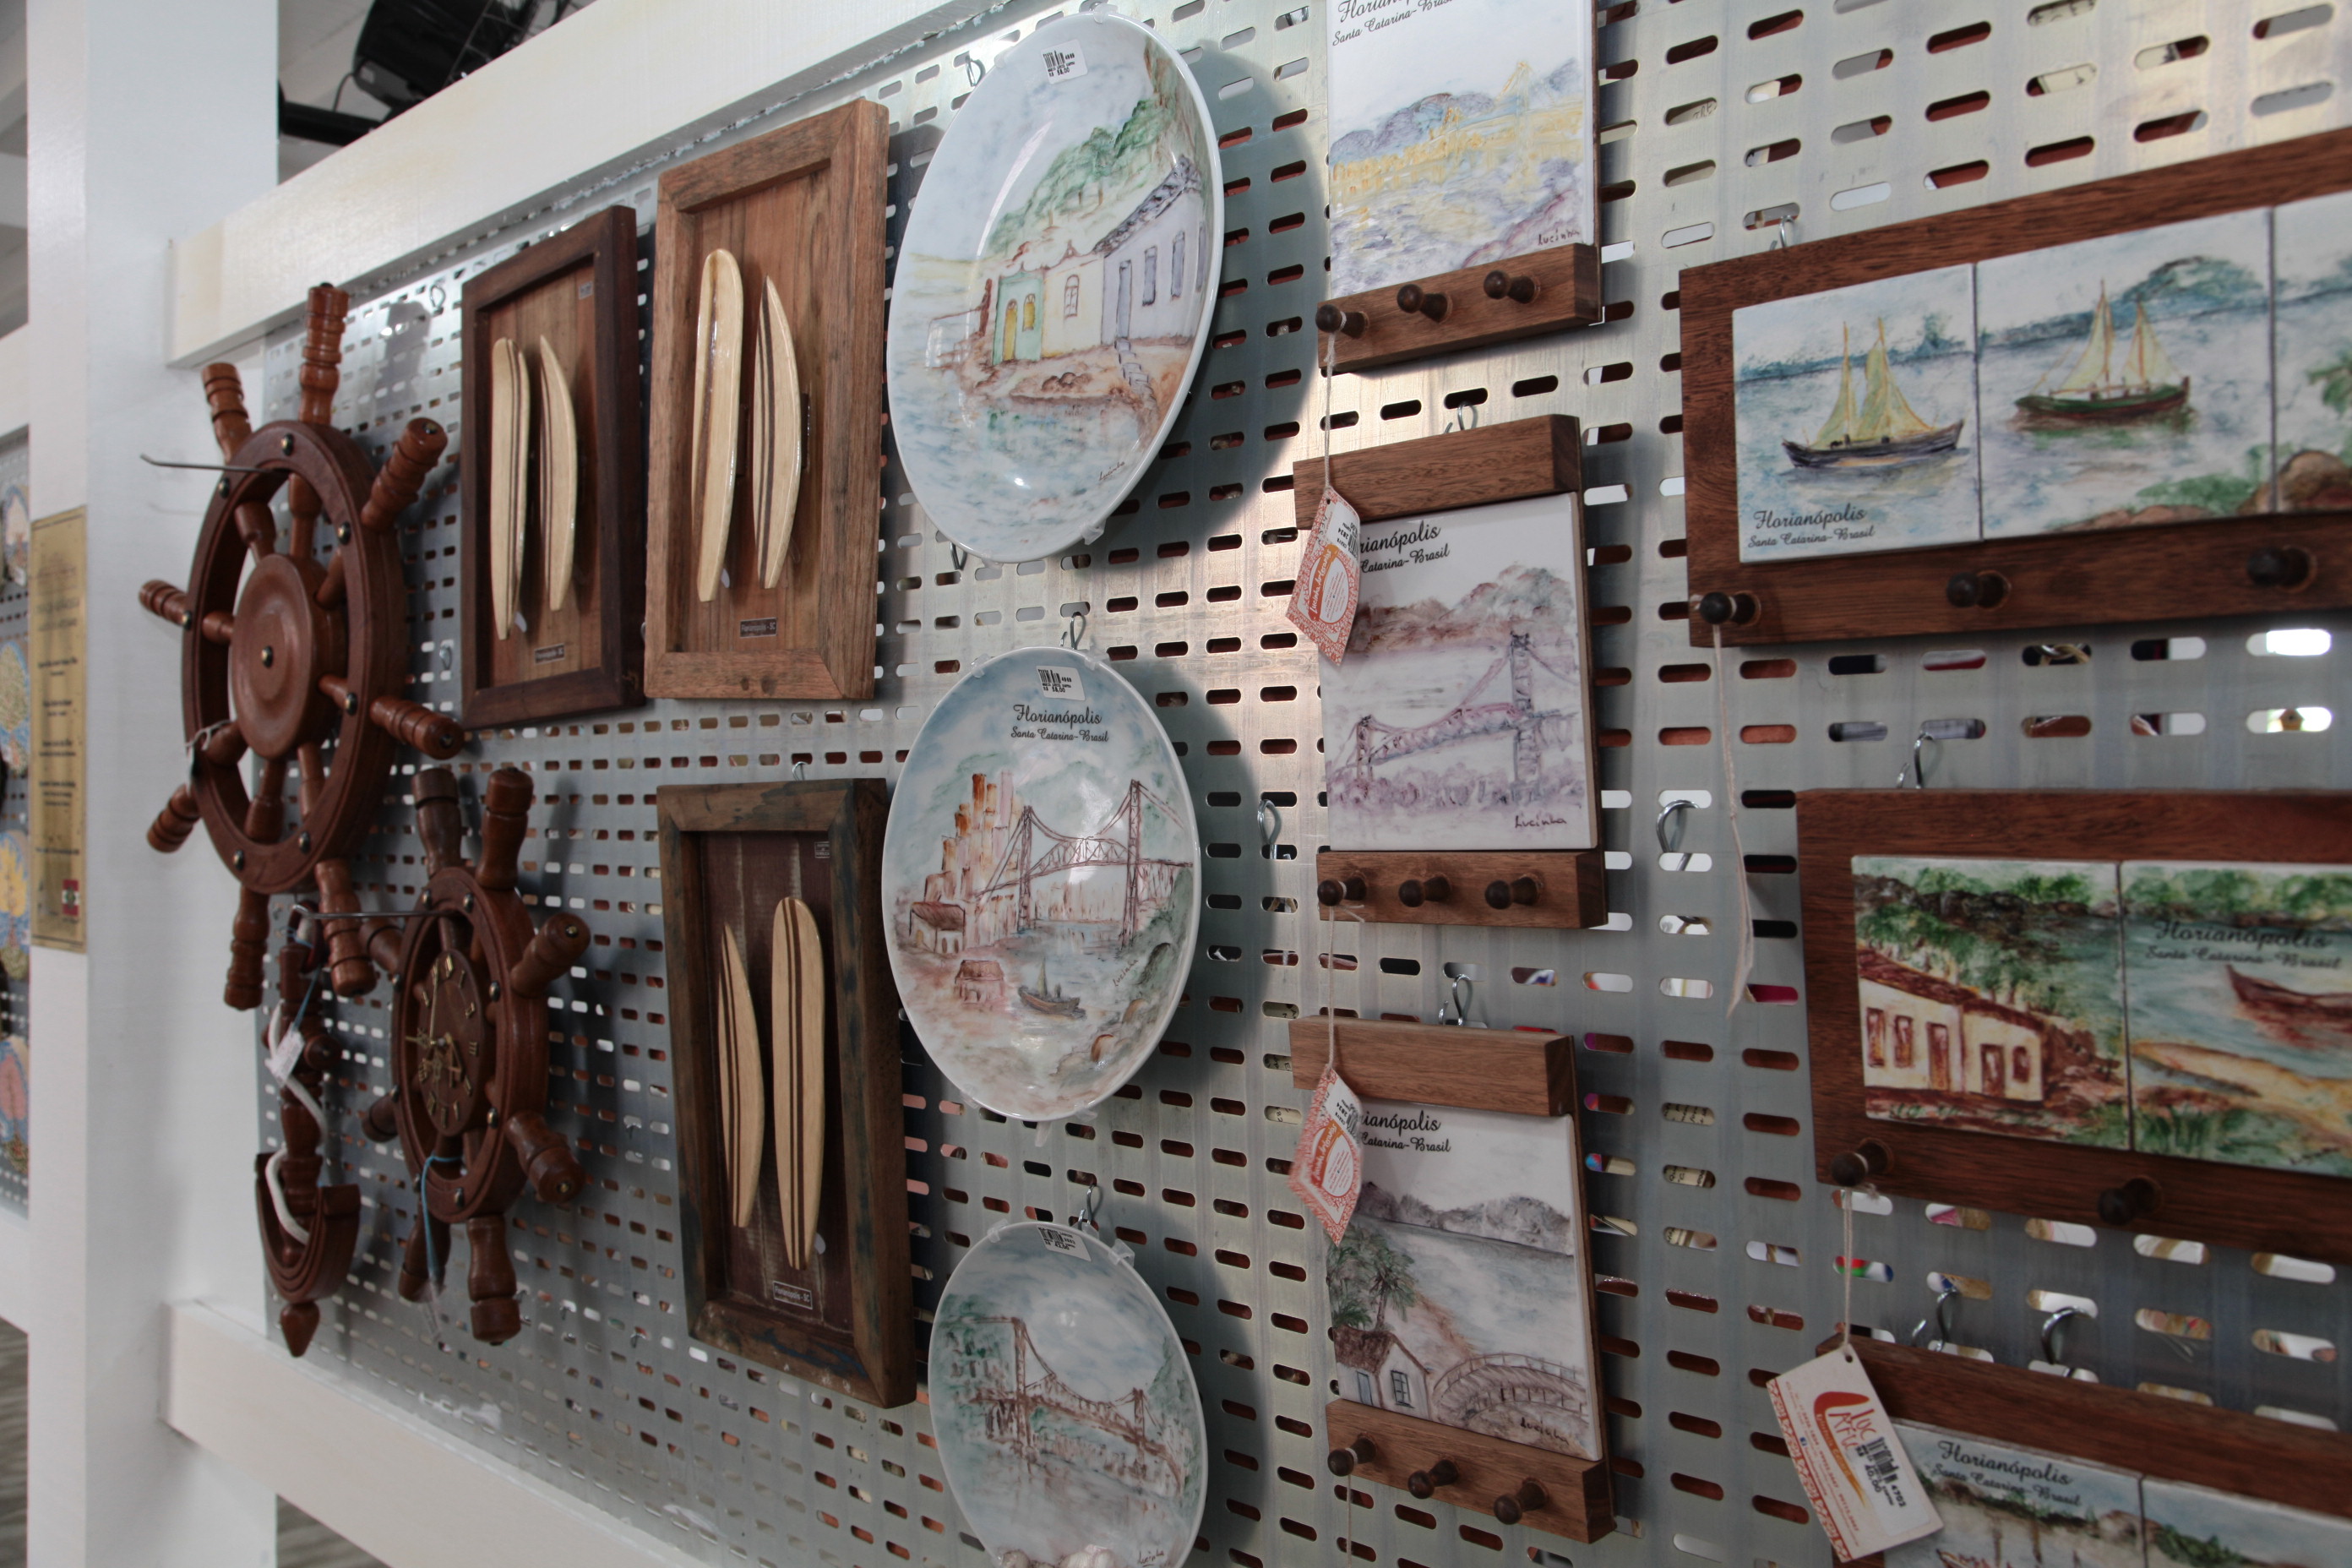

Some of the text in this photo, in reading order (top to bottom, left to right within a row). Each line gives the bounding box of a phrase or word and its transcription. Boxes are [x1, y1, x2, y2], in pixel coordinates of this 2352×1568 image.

[1332, 29, 1363, 46] Santa
[1753, 503, 1866, 530] Florianópolis
[1359, 520, 1441, 554] rianópolis
[1748, 535, 1778, 548] Santa
[1013, 704, 1102, 730] Florianópolis
[1010, 726, 1036, 738] Santa
[1361, 1109, 1441, 1136] ianópolis
[1932, 1463, 1967, 1482] Santa
[1937, 1440, 2073, 1485] Florianópolis
